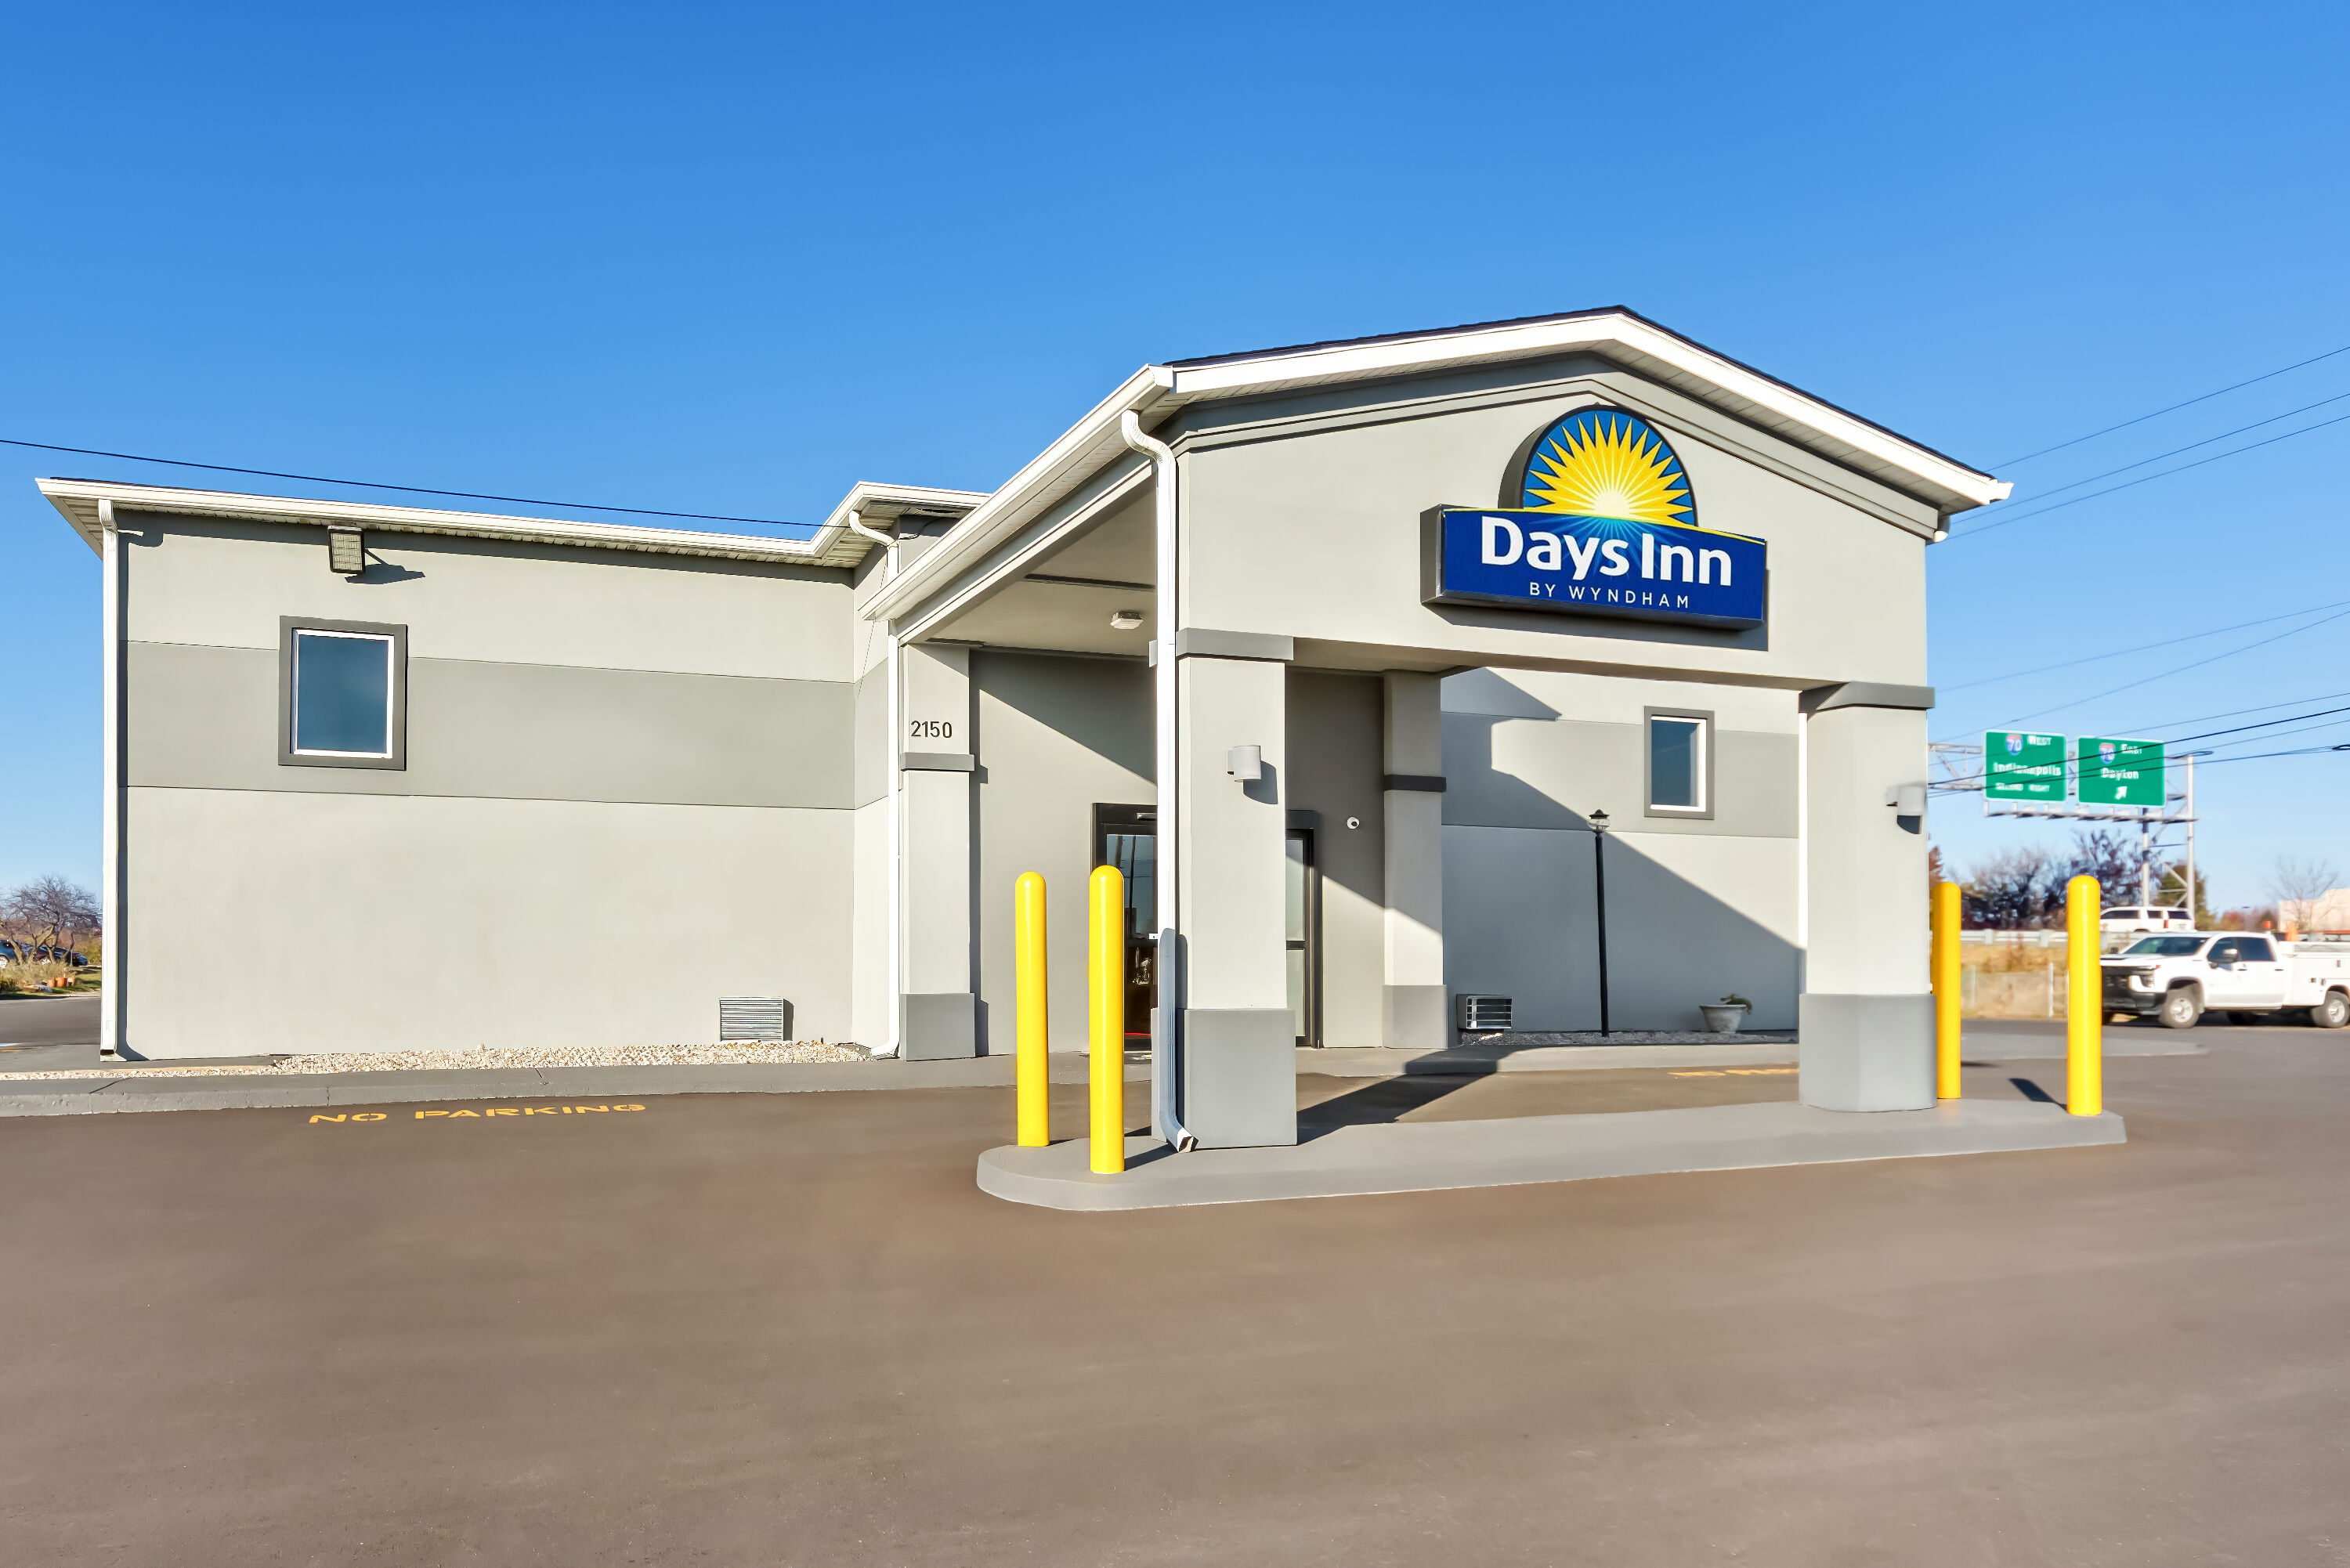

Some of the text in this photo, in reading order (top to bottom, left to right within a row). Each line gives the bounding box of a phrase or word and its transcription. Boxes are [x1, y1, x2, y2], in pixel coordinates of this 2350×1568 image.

[1481, 515, 1732, 587] Days Inn
[1530, 582, 1689, 609] BY WYNDHAM
[910, 720, 953, 739] 2150
[2007, 739, 2022, 751] 70
[309, 1104, 646, 1124] NO PARKING
